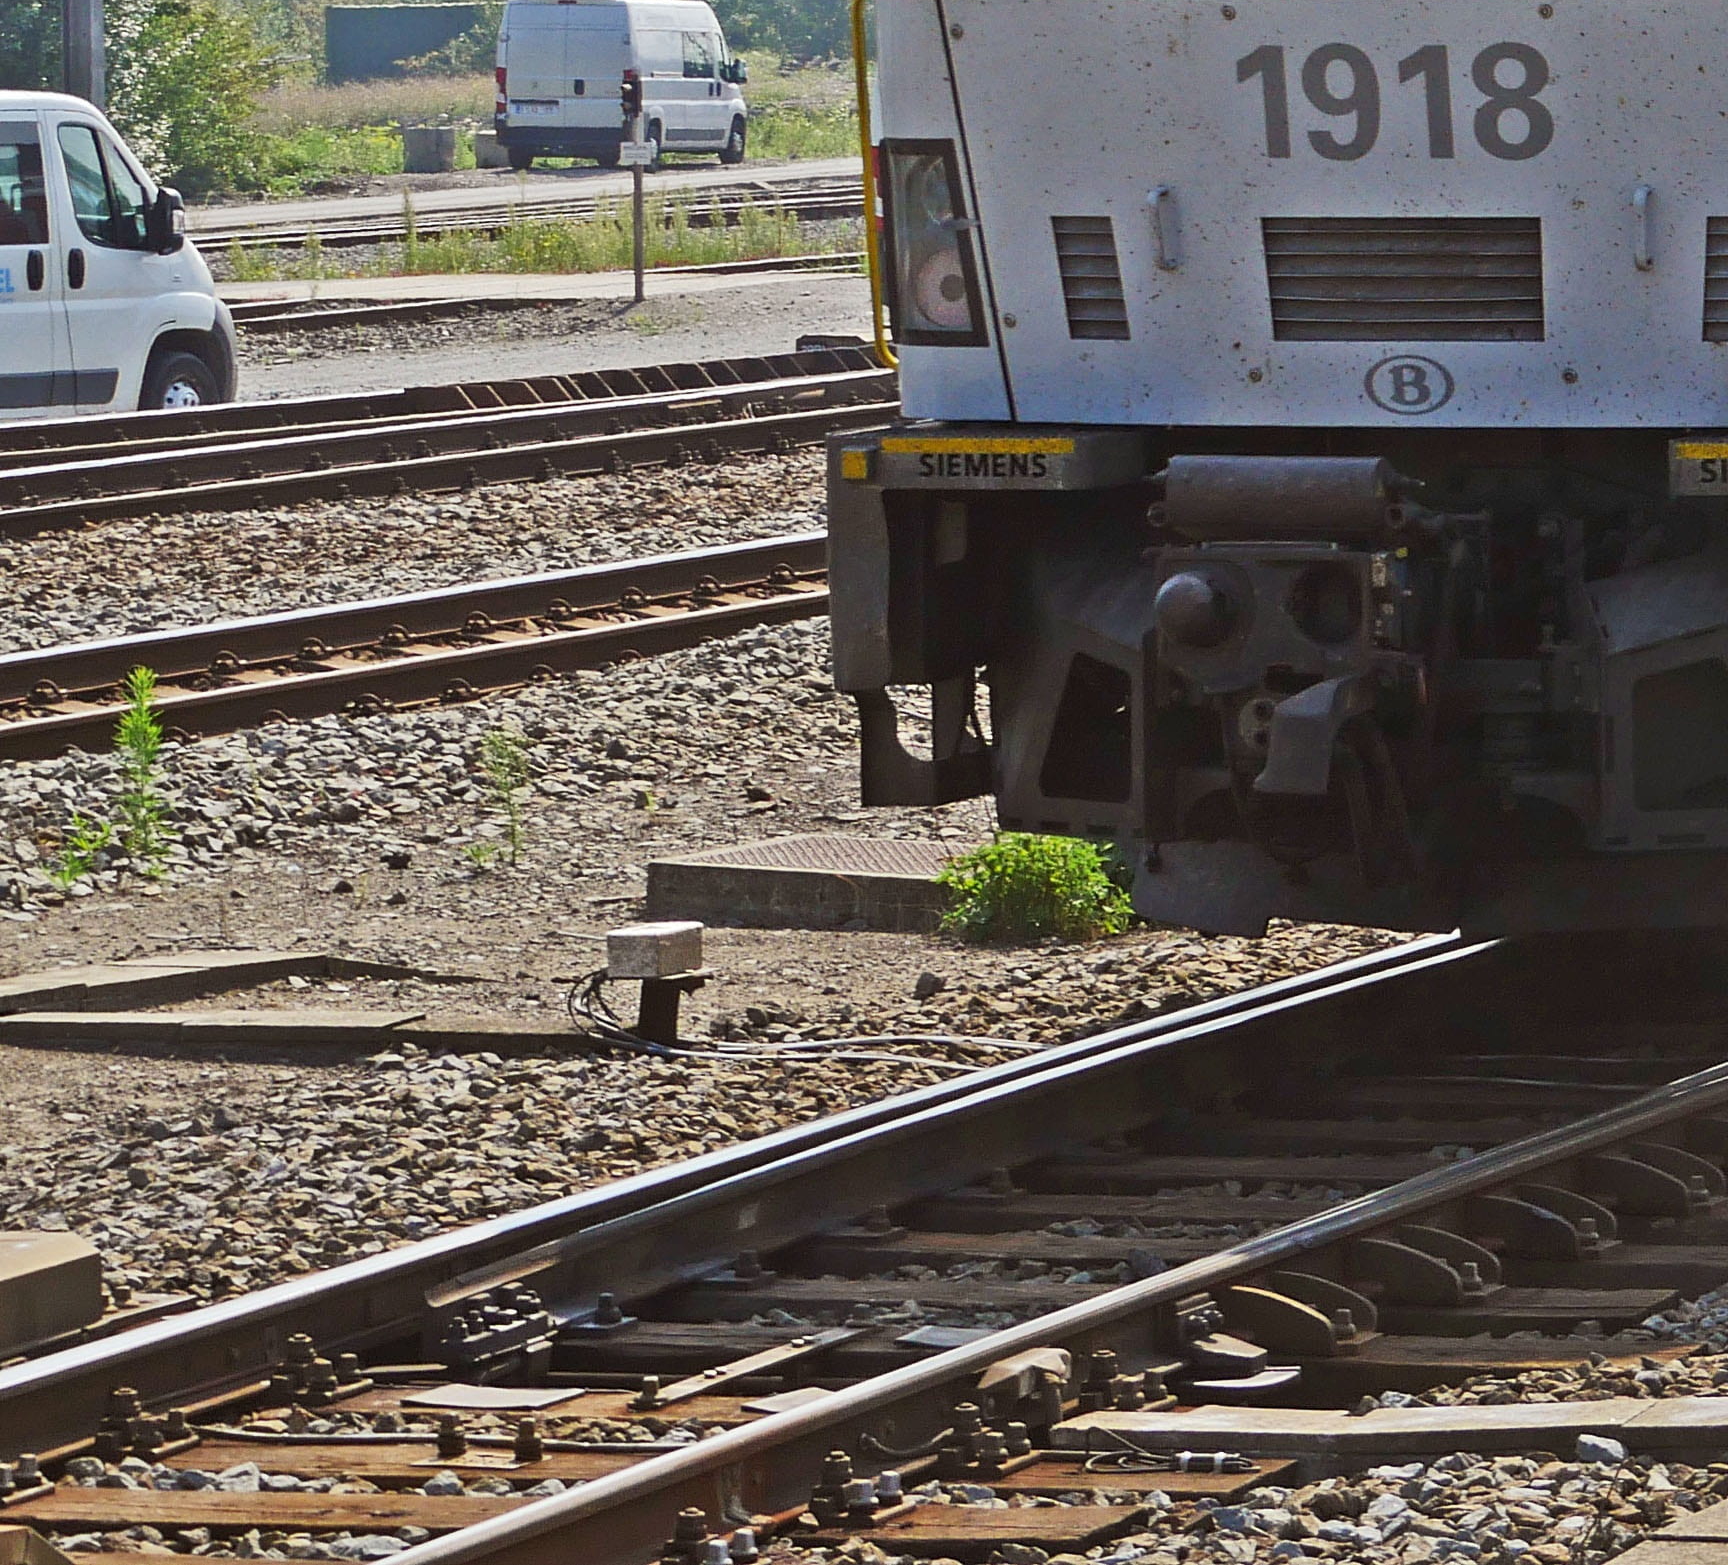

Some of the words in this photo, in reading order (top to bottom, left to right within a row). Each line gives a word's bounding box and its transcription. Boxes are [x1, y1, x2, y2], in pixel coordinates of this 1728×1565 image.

[1235, 40, 1555, 162] 1918
[1387, 364, 1431, 406] B
[918, 453, 1048, 478] SIEMENS
